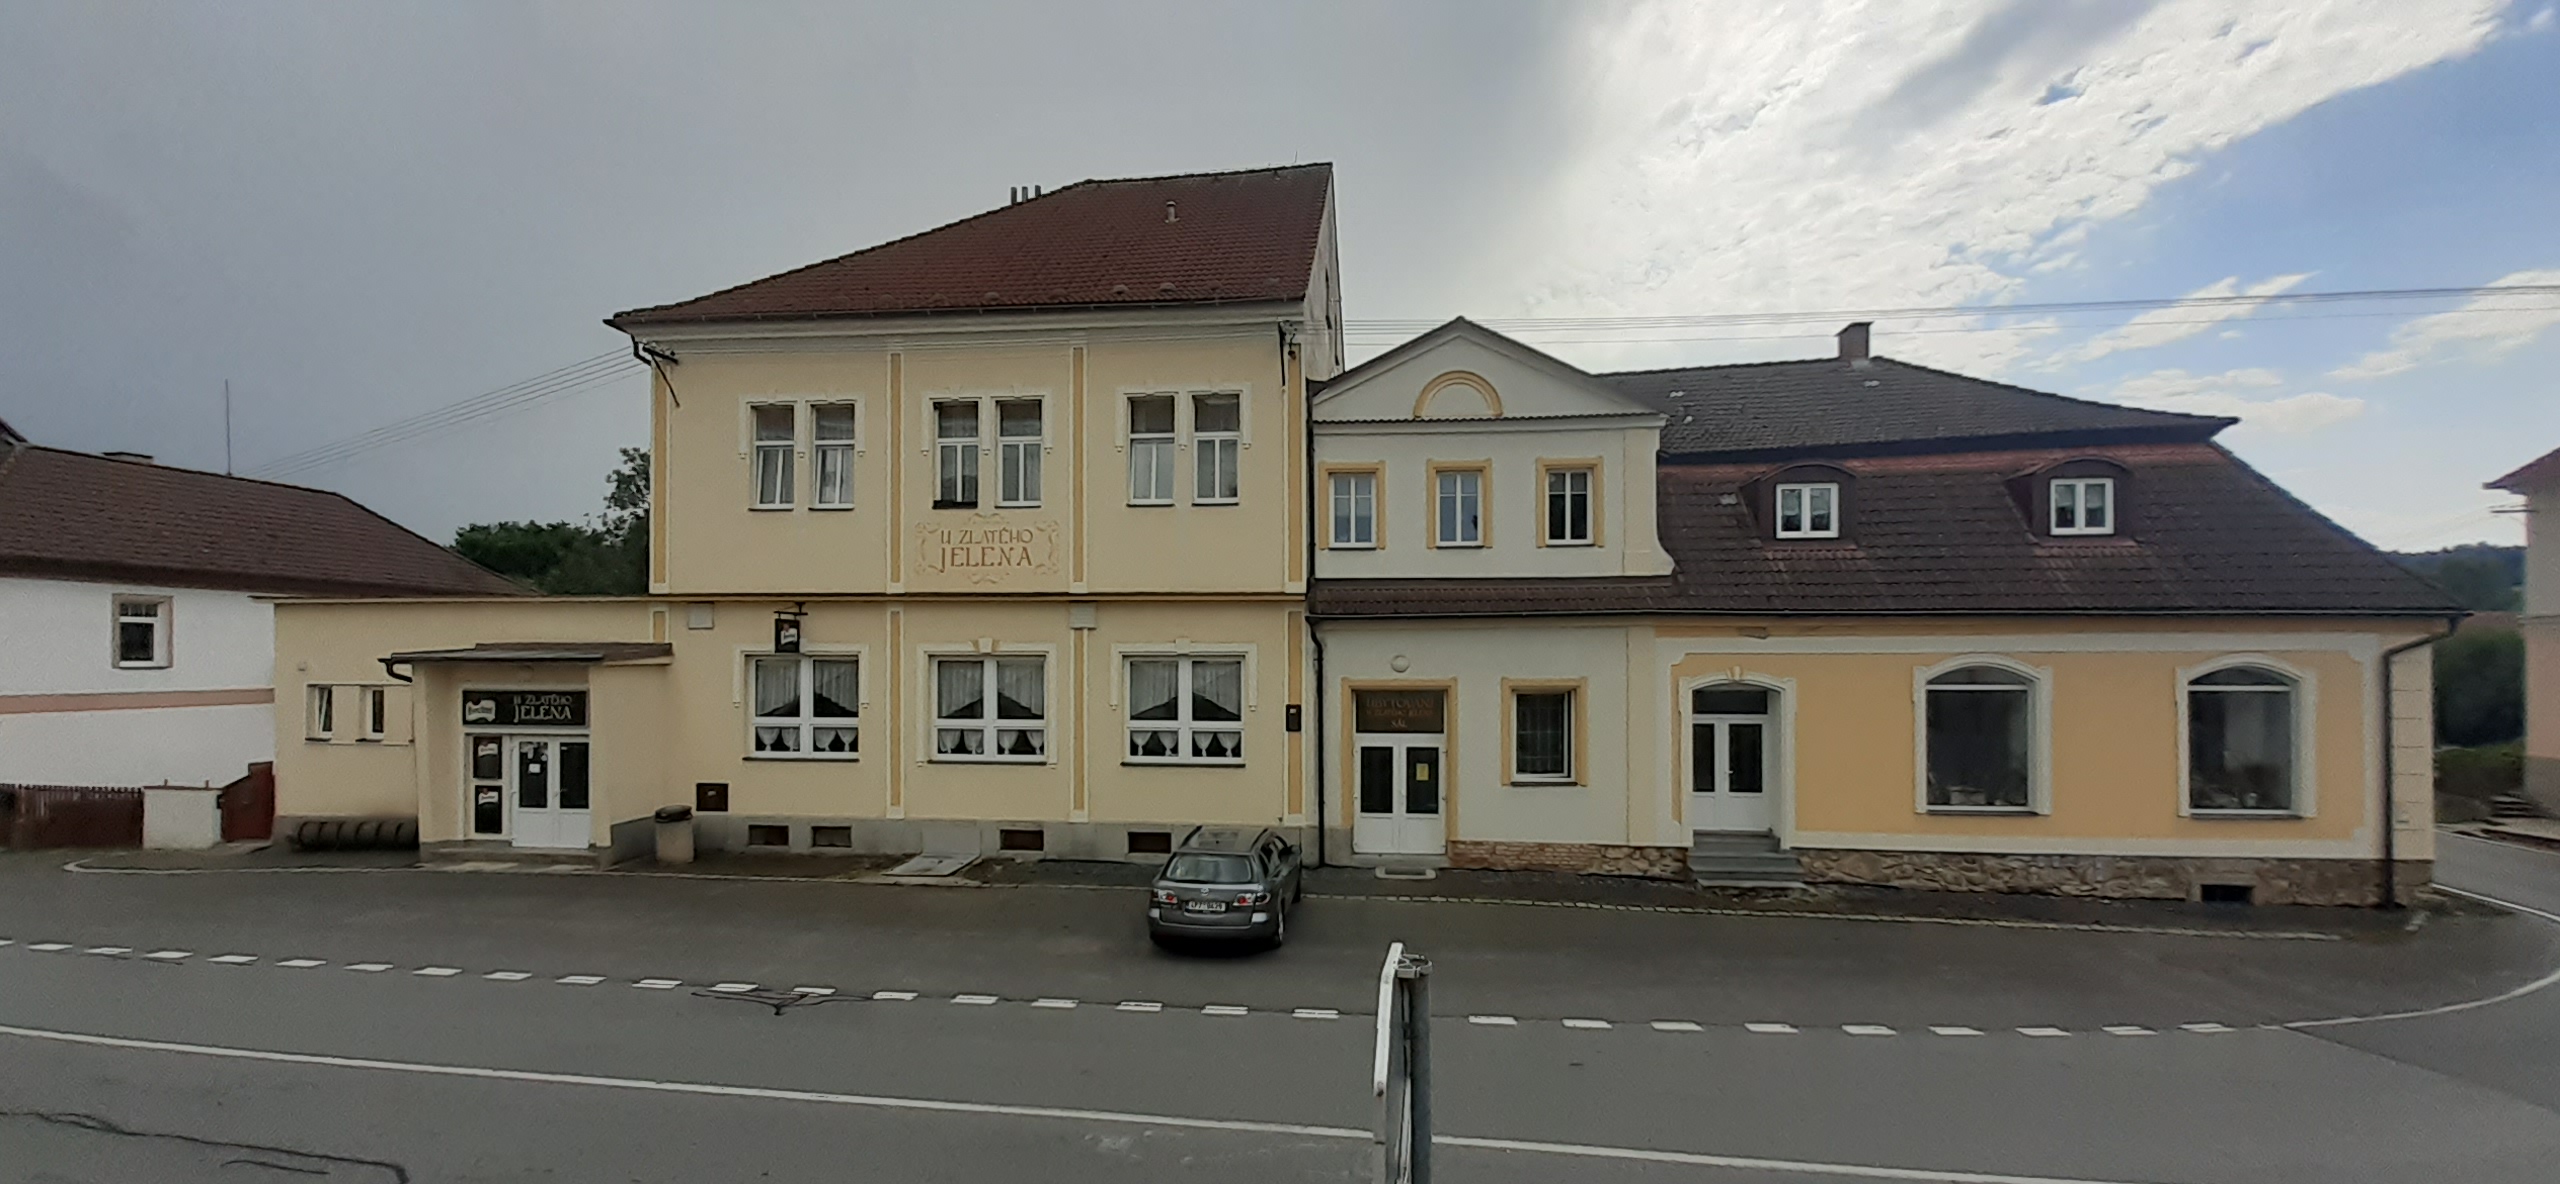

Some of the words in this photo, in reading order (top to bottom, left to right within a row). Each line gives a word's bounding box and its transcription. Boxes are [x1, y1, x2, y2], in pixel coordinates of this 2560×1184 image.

[940, 529, 951, 545] U
[958, 526, 1034, 545] ZLATÉHO
[939, 546, 1033, 573] JELENA
[513, 704, 572, 723] JELENA
